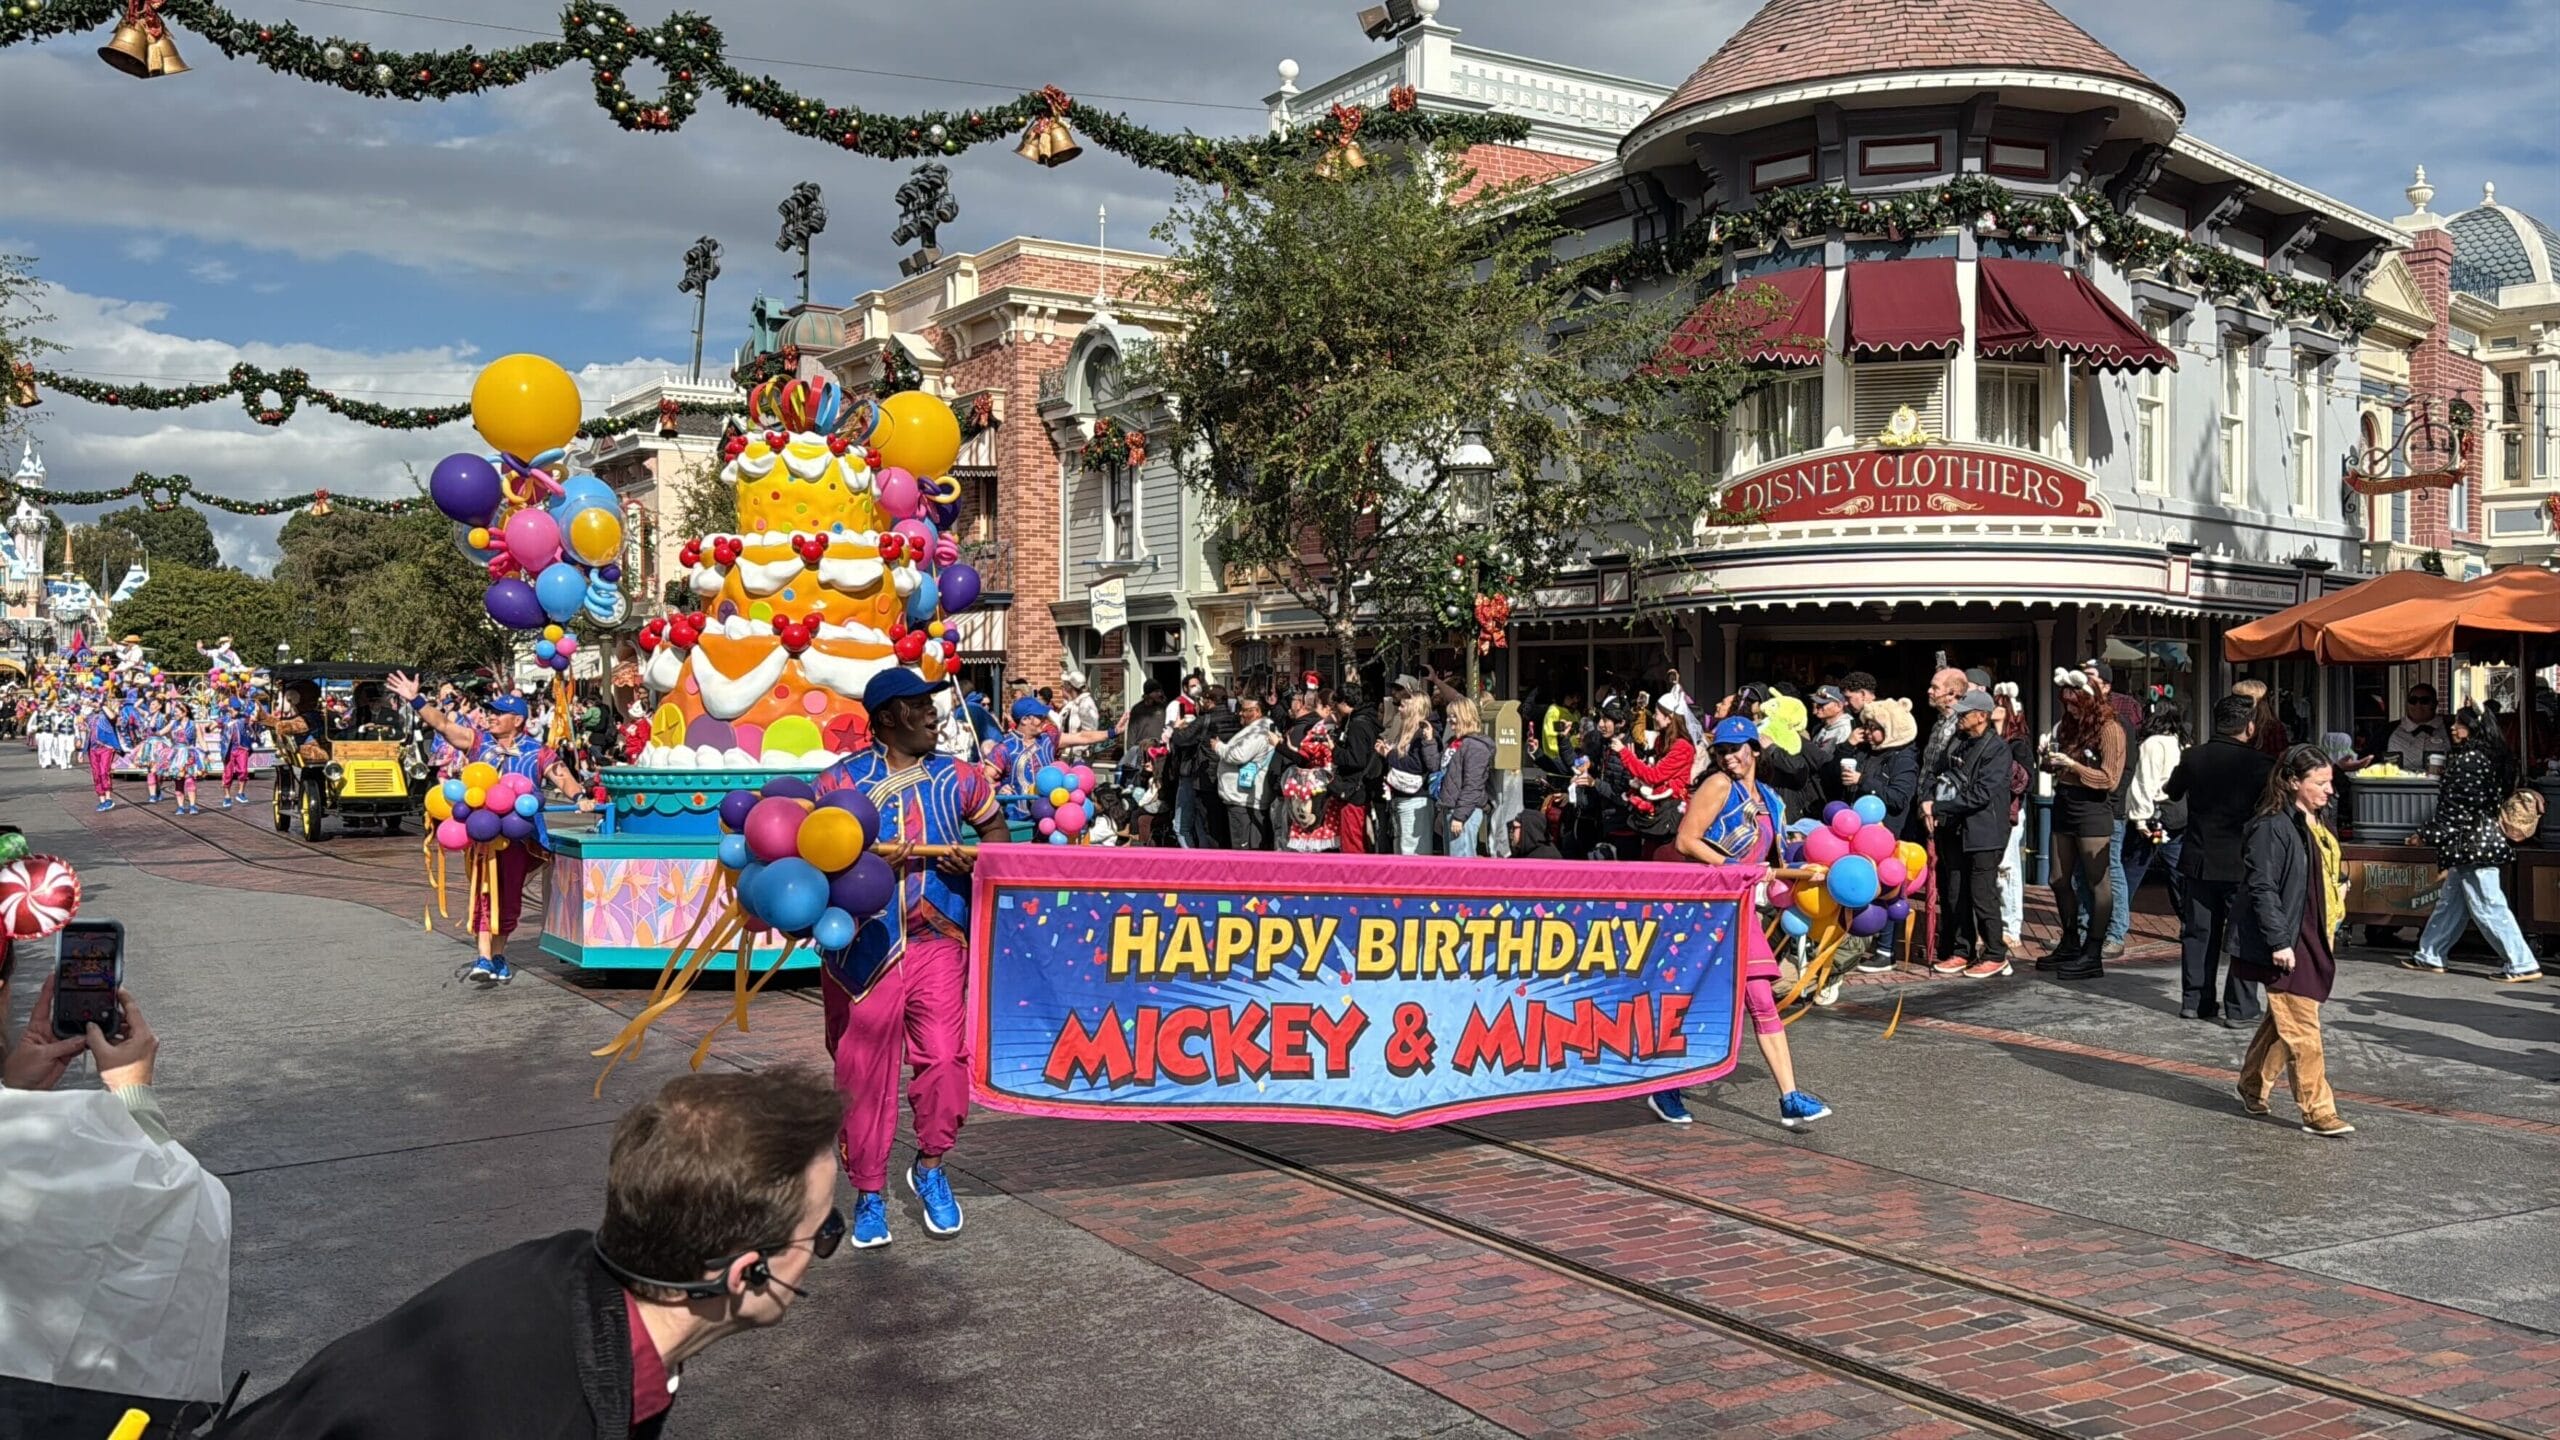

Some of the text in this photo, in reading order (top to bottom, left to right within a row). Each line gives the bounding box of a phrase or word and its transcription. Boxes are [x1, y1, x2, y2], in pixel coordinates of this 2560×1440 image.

[1745, 454, 2064, 510] DISNEY CLOTHIERS
[1881, 494, 1920, 513] LTD.
[1501, 728, 1516, 736] U.S.
[2363, 863, 2412, 892] Market
[1106, 913, 1661, 983] HAPPY BIRTHDAY
[1042, 991, 1694, 1091] MICKEY & MINNIE
